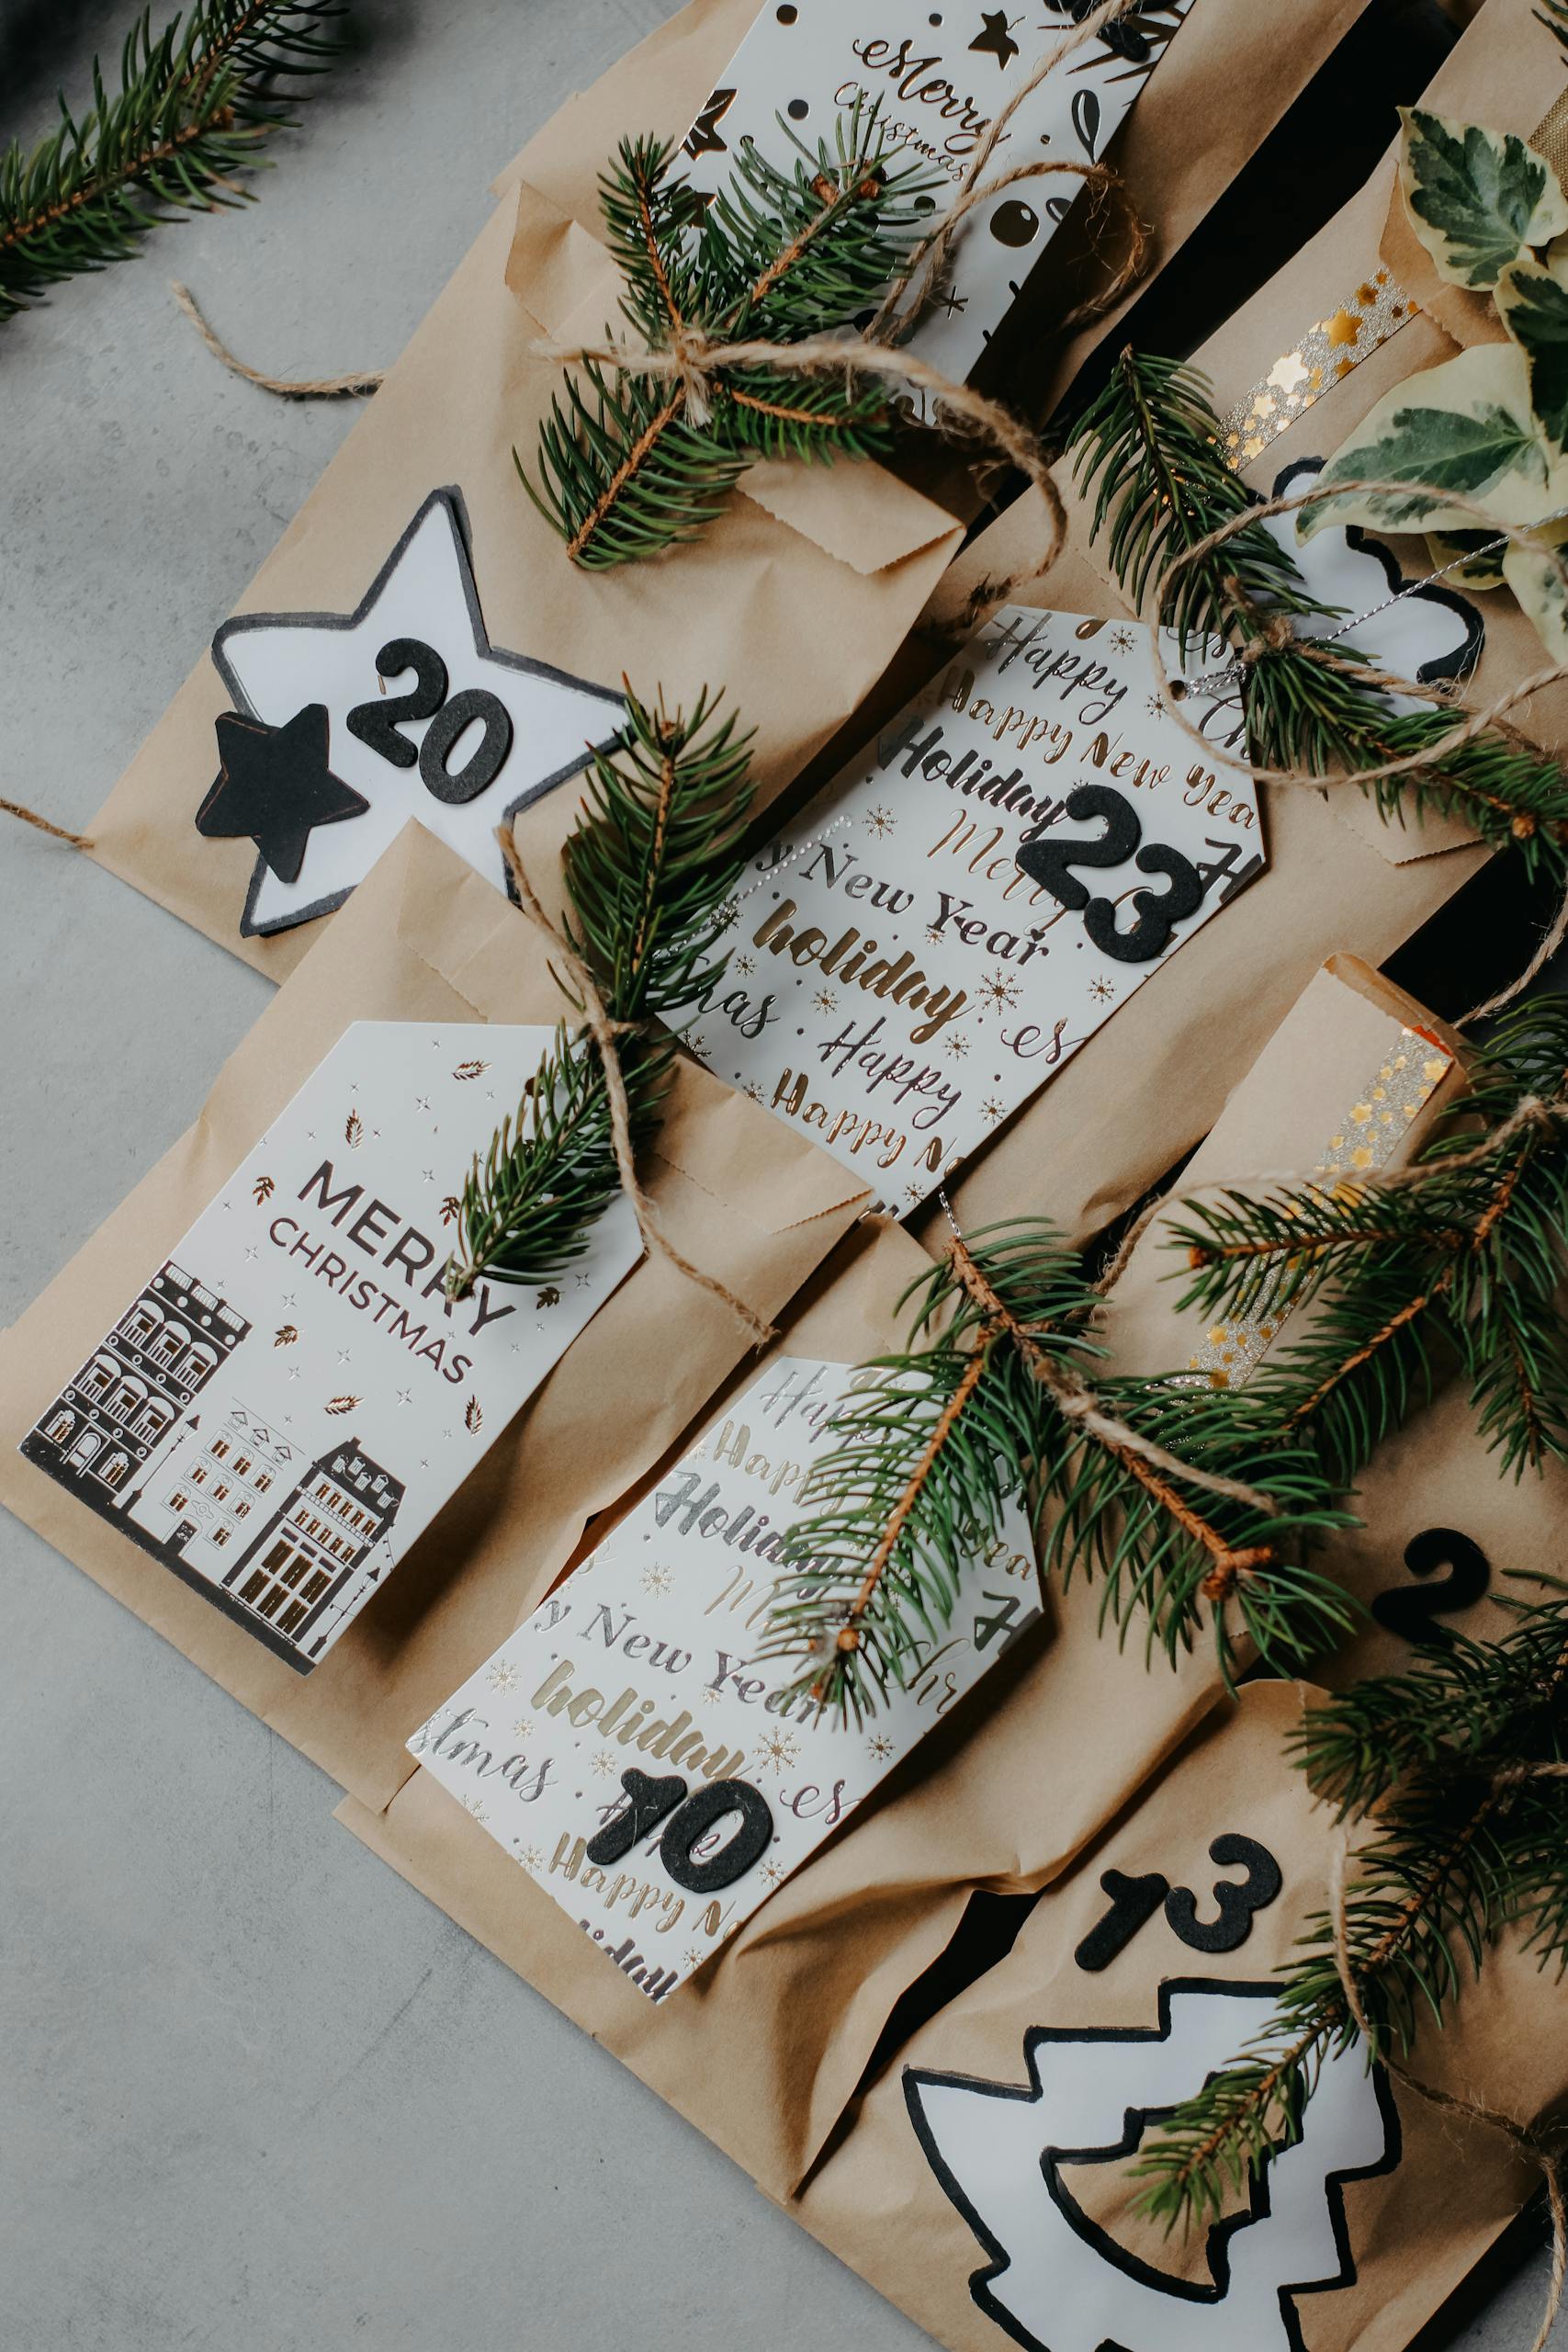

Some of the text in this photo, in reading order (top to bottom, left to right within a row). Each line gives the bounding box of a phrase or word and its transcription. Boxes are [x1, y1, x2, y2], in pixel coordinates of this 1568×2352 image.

[346, 638, 514, 805] 20
[986, 613, 1128, 725] Happy
[878, 720, 1069, 843] Holiday
[1079, 732, 1175, 790] New
[798, 843, 915, 914] New
[927, 890, 1051, 966] Year
[1015, 785, 1205, 964] 23
[752, 898, 976, 1046] holiday
[770, 1068, 908, 1169] Happy
[817, 1015, 963, 1130] Happy
[269, 1216, 474, 1384] CHRISTMAS
[297, 1159, 516, 1337] MERRY
[576, 1602, 694, 1675] New
[548, 1831, 687, 1934] Happy
[585, 1767, 774, 1894] 10
[1074, 1832, 1282, 1972] 13
